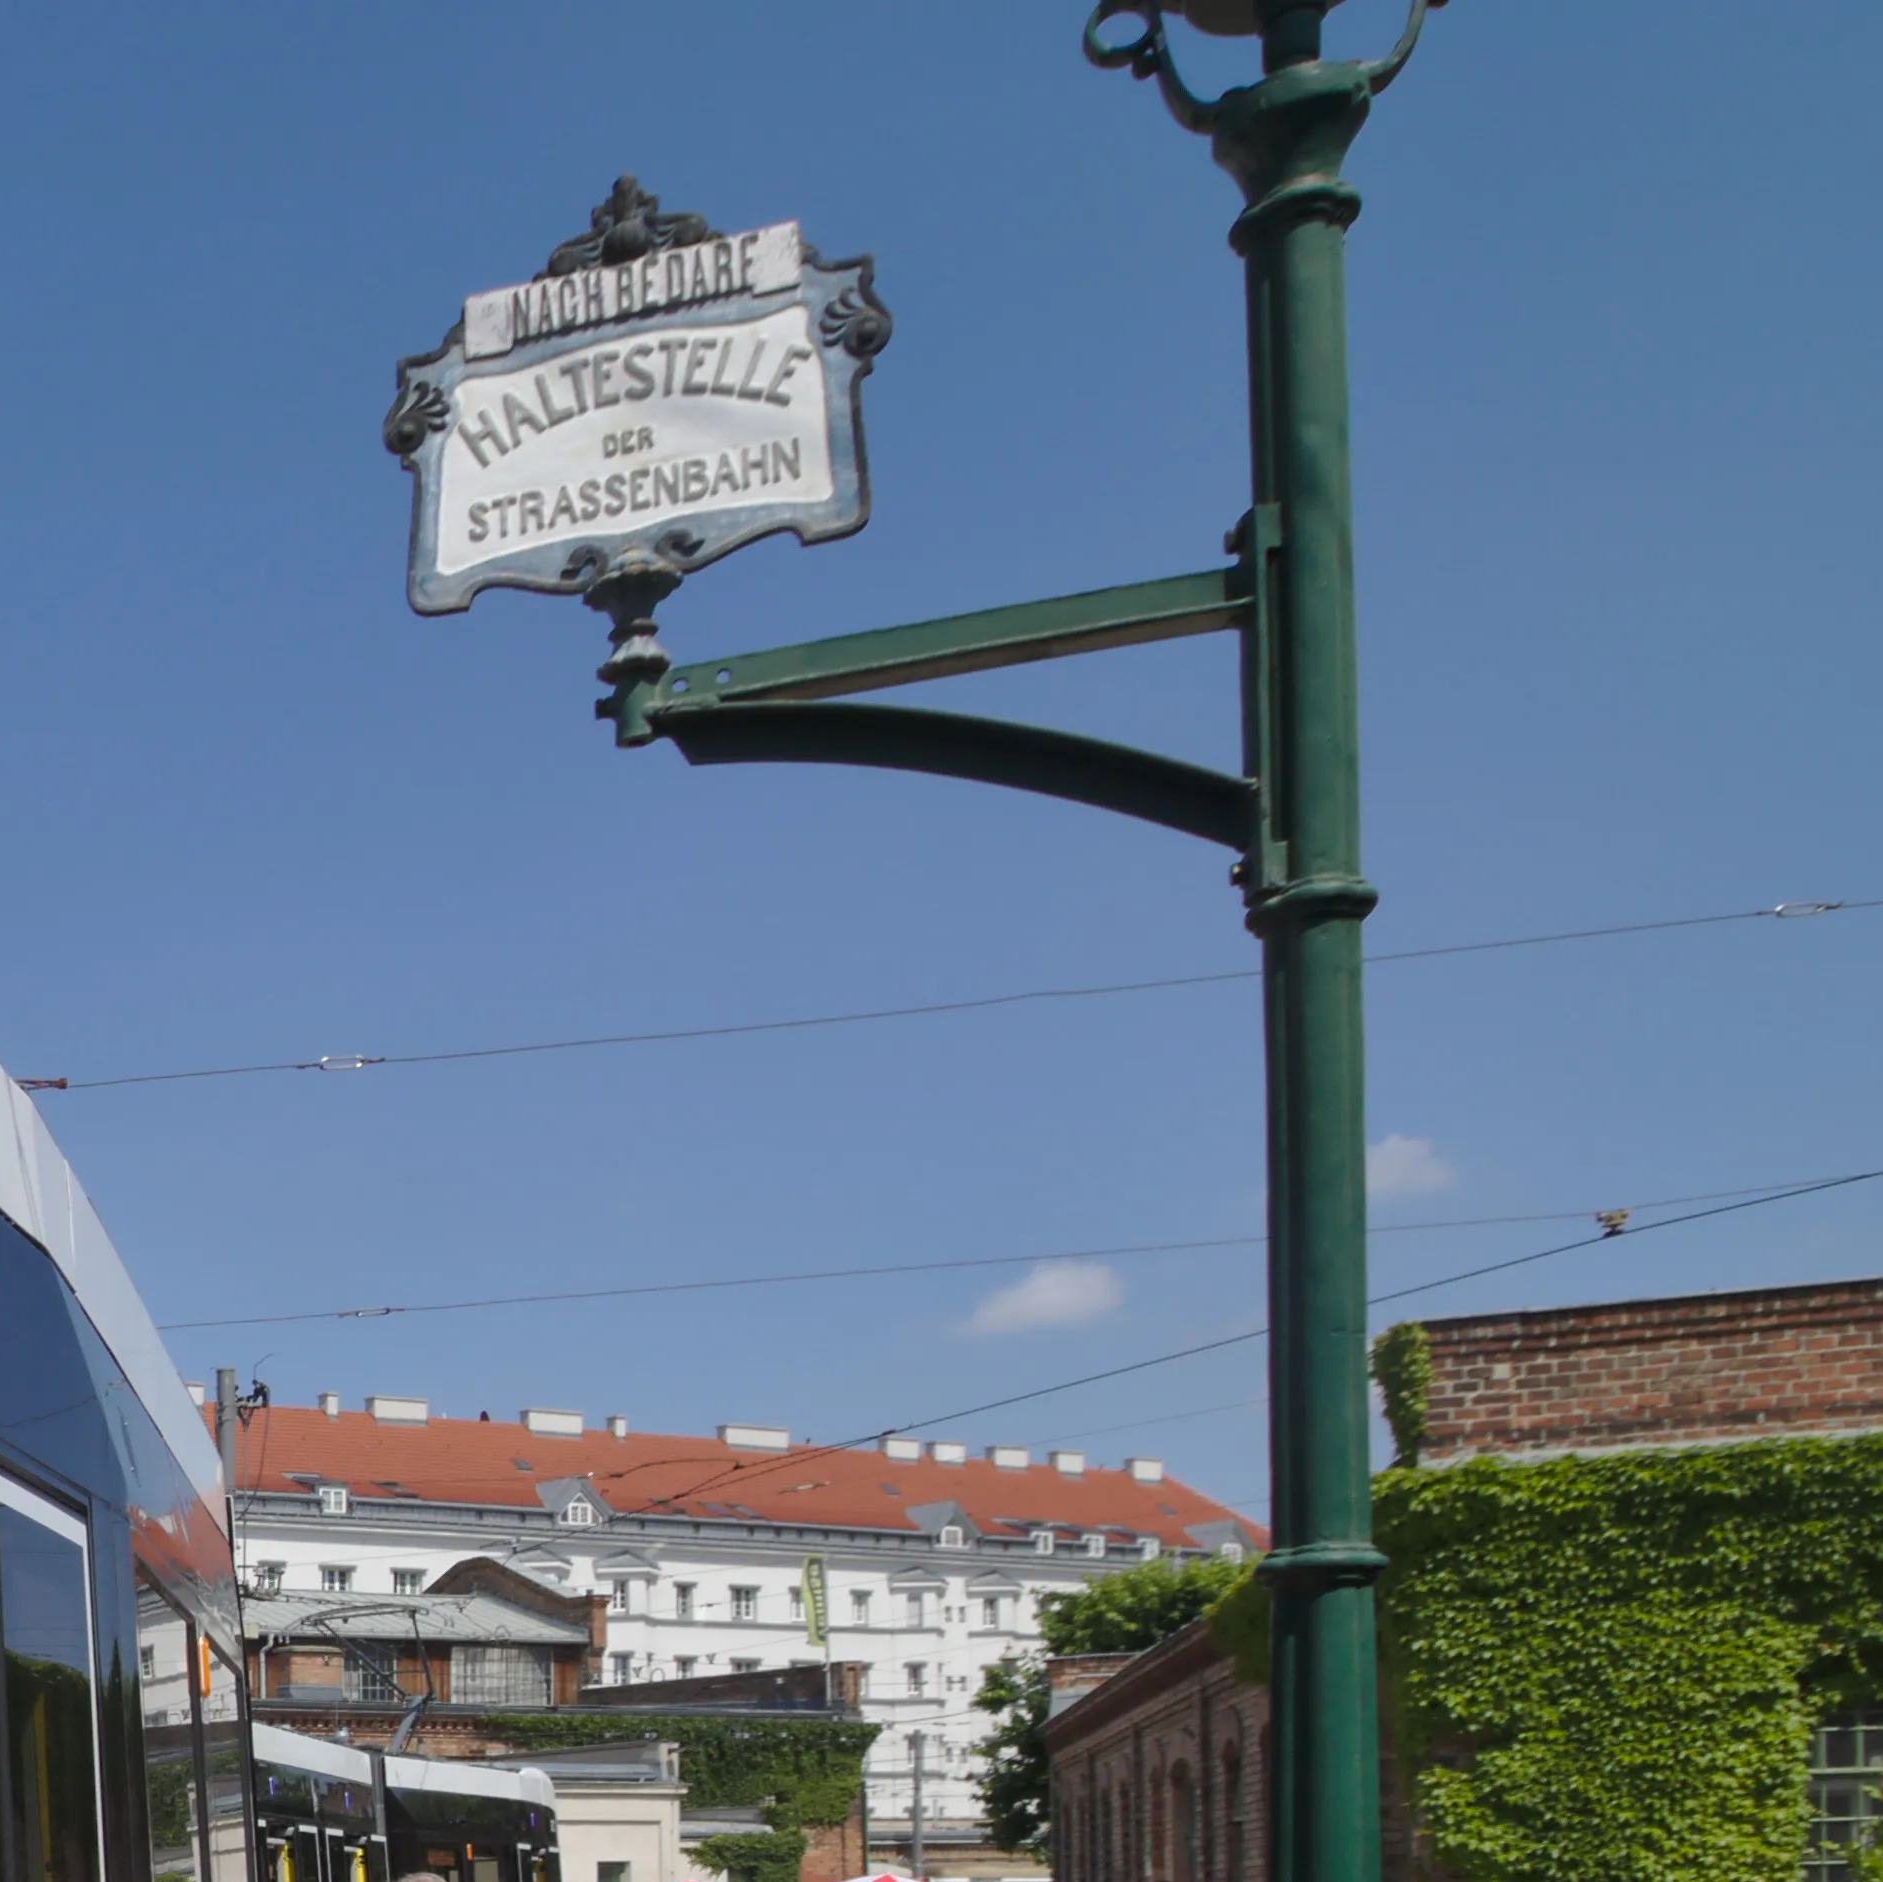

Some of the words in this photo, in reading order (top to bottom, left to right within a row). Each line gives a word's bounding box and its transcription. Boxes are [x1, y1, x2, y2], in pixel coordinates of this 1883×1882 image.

[510, 268, 604, 341] NACH
[458, 336, 813, 467] HALTESTELLE
[602, 426, 655, 460] DER
[467, 438, 801, 543] STRASSENBAHN
